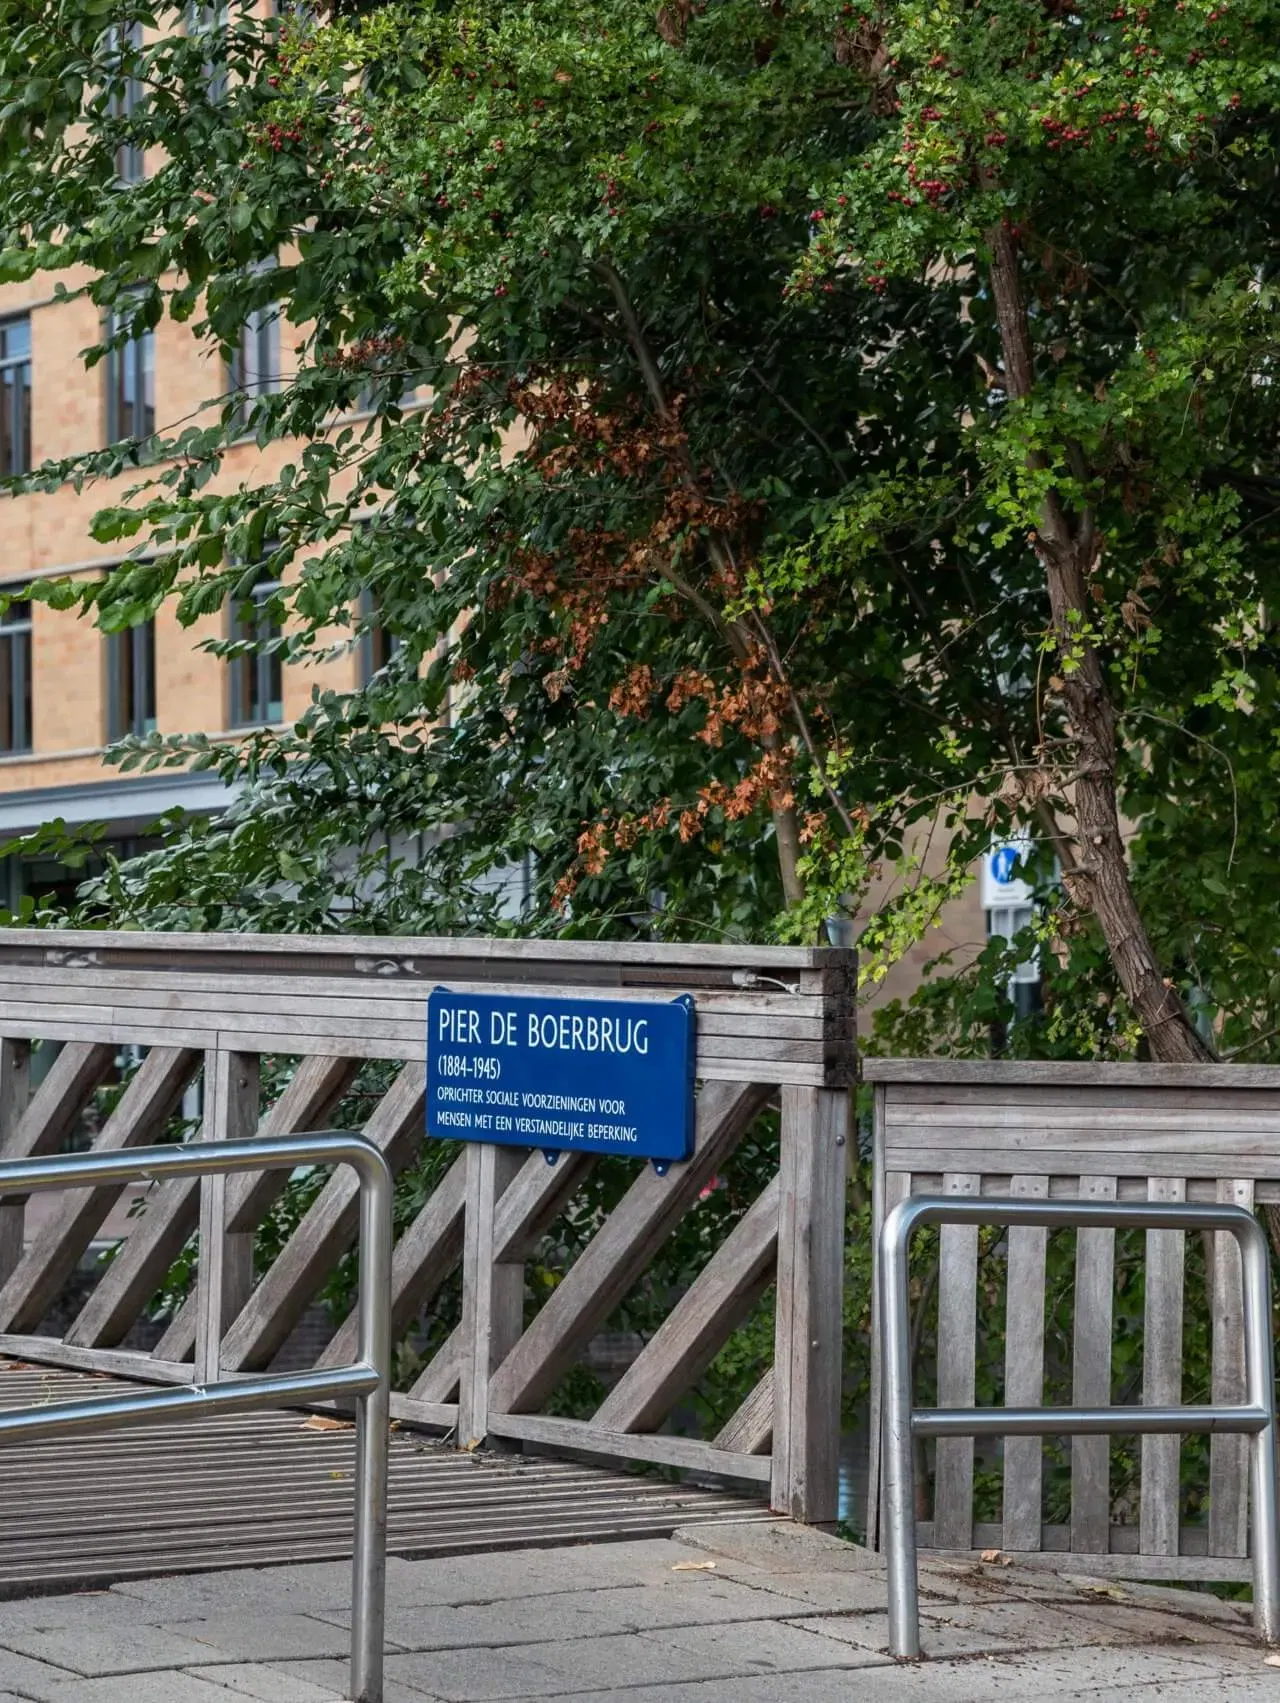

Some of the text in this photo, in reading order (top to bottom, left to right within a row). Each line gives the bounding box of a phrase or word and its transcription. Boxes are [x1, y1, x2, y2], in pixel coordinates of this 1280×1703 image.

[439, 1008, 649, 1054] PIER DE BOERBRUG
[437, 1087, 626, 1115] OPRICHTER SOCIALE VOORZIENINGEN VOOR
[437, 1112, 637, 1142] MENSEN MET EEN VERSTANDELIJKE BEPERKING
